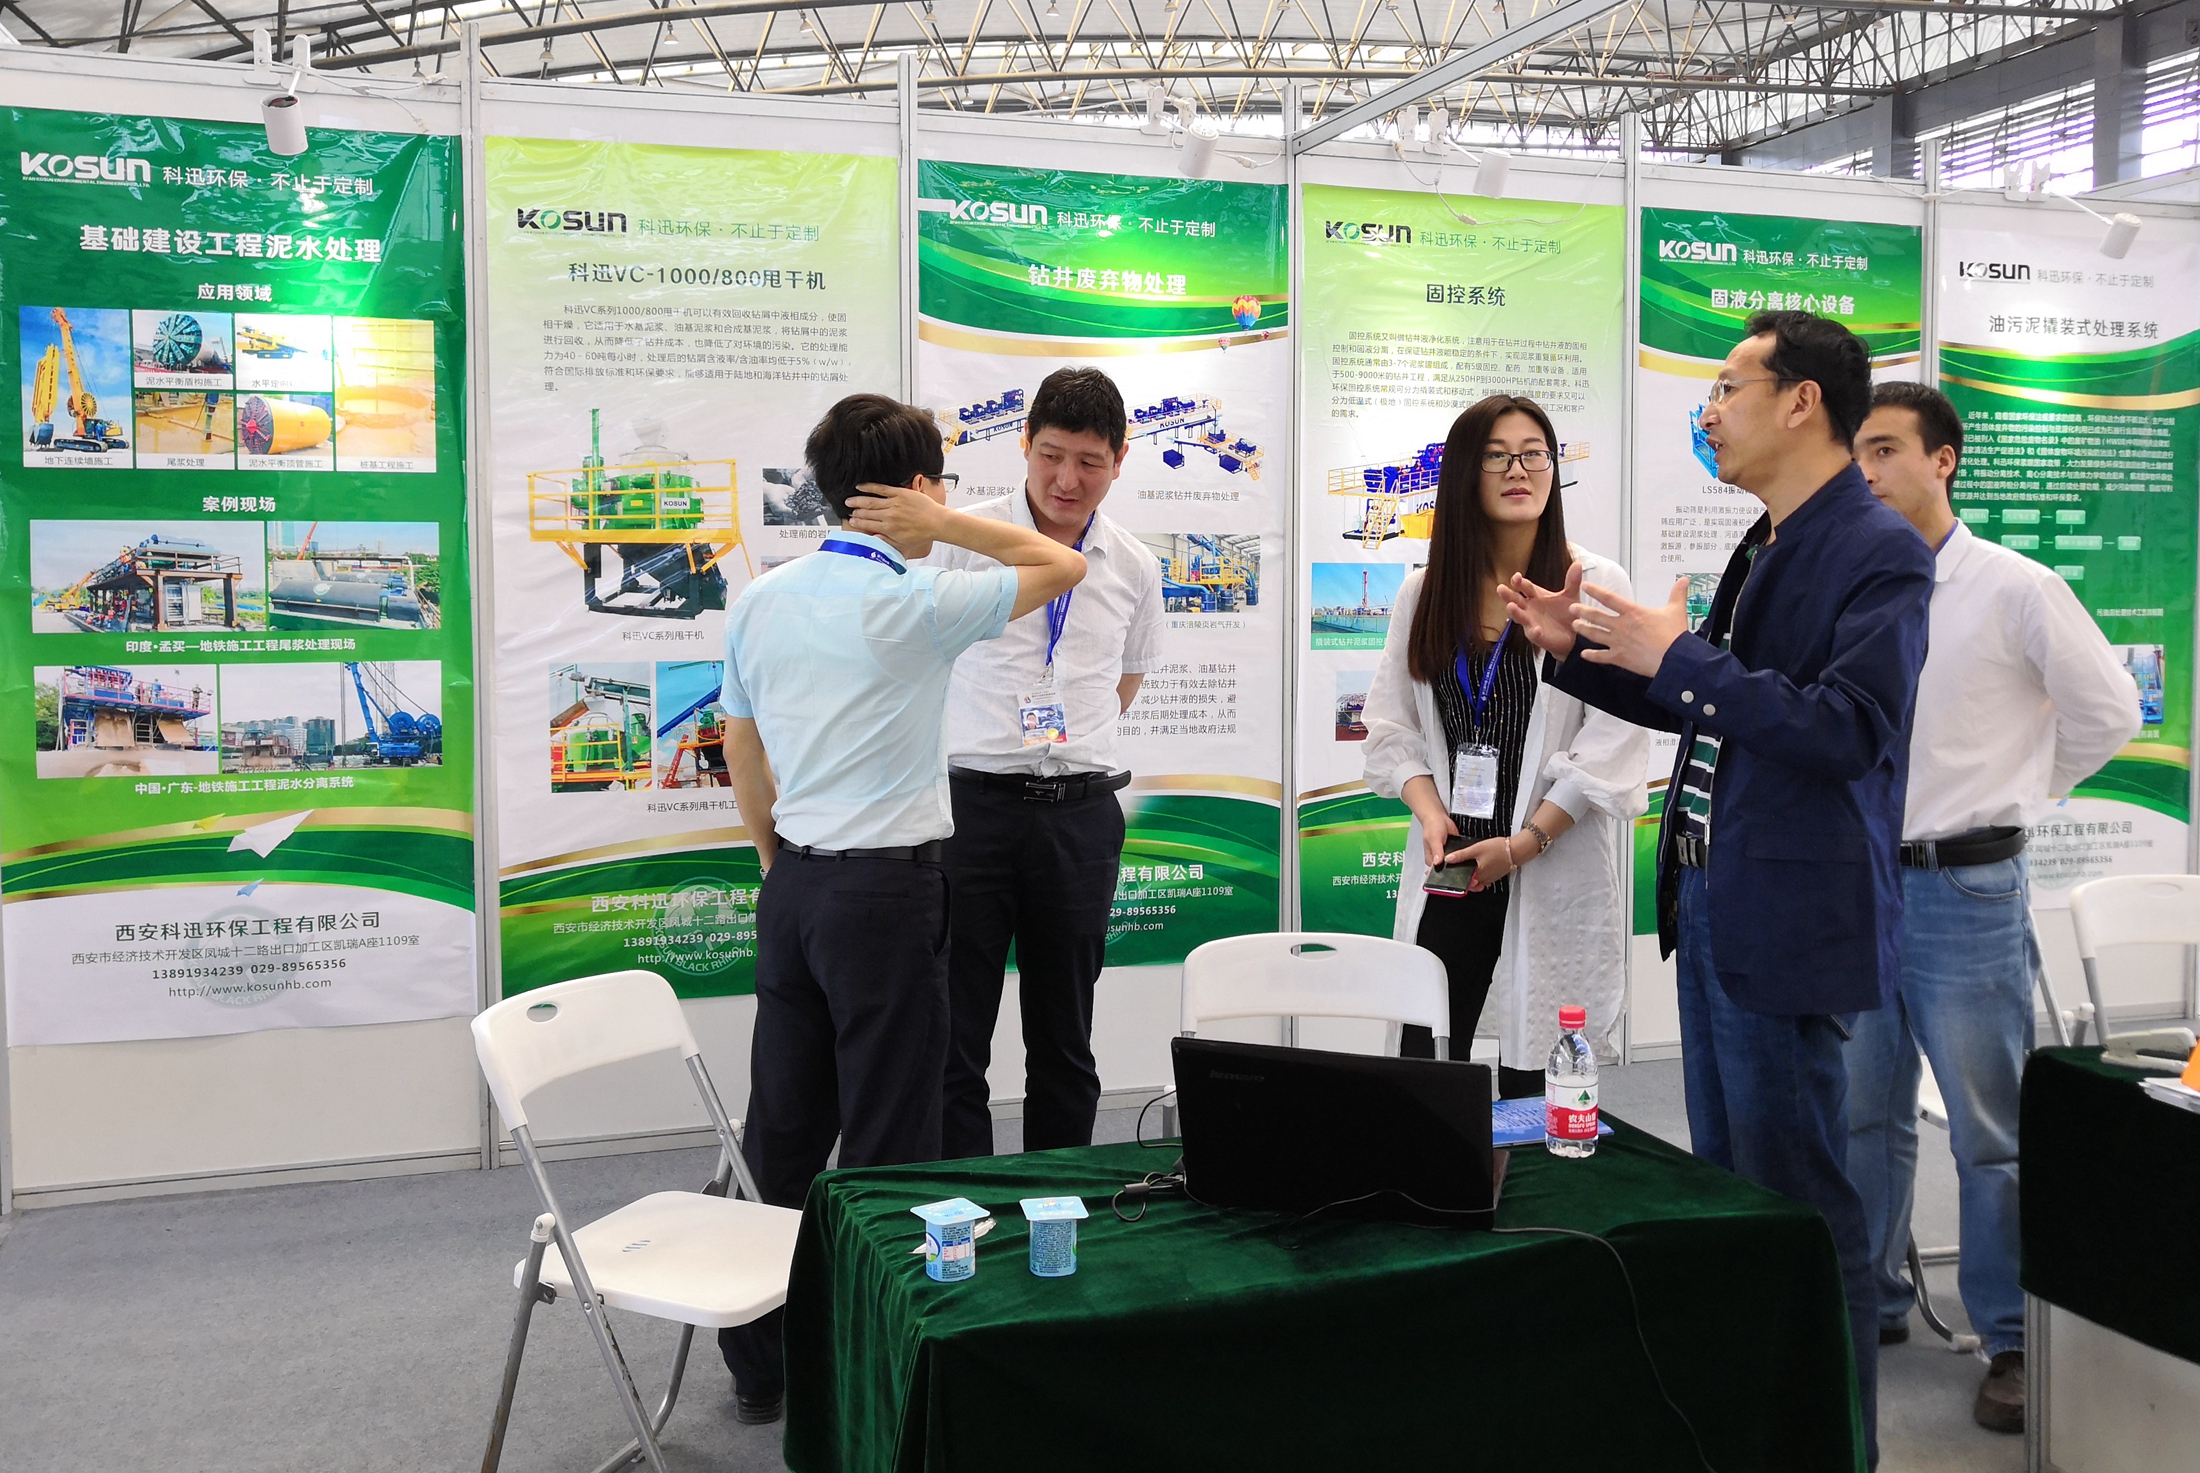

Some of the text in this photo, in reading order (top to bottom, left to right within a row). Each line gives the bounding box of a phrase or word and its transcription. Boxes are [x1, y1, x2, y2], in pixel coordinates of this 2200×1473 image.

[21, 151, 151, 182] KOSUN
[517, 208, 627, 233] KOSUN
[950, 200, 1047, 225] KOSUN
[1325, 220, 1411, 244] KOSUN
[80, 225, 382, 263] 基础建设工程泥水处理
[1659, 239, 1737, 262] KOSUN
[568, 262, 826, 290] 科迅VC-1000/800甩干机
[1029, 264, 1186, 295] 钻井废弃物处理
[1959, 261, 2030, 280] KOSUN
[197, 282, 273, 303] 应用领域
[1426, 283, 1506, 306] 固控系统
[1711, 289, 1855, 315] 固液分离核心设备
[1989, 315, 2159, 339] 油污泥撬装式处理系统
[145, 376, 223, 388] 泥水平衡盾构施工
[544, 382, 559, 392] 理。
[44, 456, 114, 467] 地下连续墙施工
[166, 458, 205, 468] 尾浆处理
[248, 458, 323, 470] 泥水平衡顶管施工
[360, 460, 414, 470] 桩基工程施工
[202, 495, 277, 513] 案例现场
[1137, 490, 1240, 502] 油基泥浆钻井废弃物处理
[779, 529, 830, 539] 处理前的岩
[622, 630, 704, 641] 科迅VC系列甩干机
[1121, 864, 1203, 882] 程有限公司
[115, 911, 380, 942] 西安科迅环保工程有限公司
[71, 934, 420, 965] 西安市经济技术开发区凤城十二路出口加工区凯瑞A座1109室
[623, 933, 703, 948] 13891934239
[152, 958, 346, 980] 13891934239 029-89565356
[676, 958, 709, 972] BLACK
[169, 978, 332, 998] http://www.kosunhb.com
